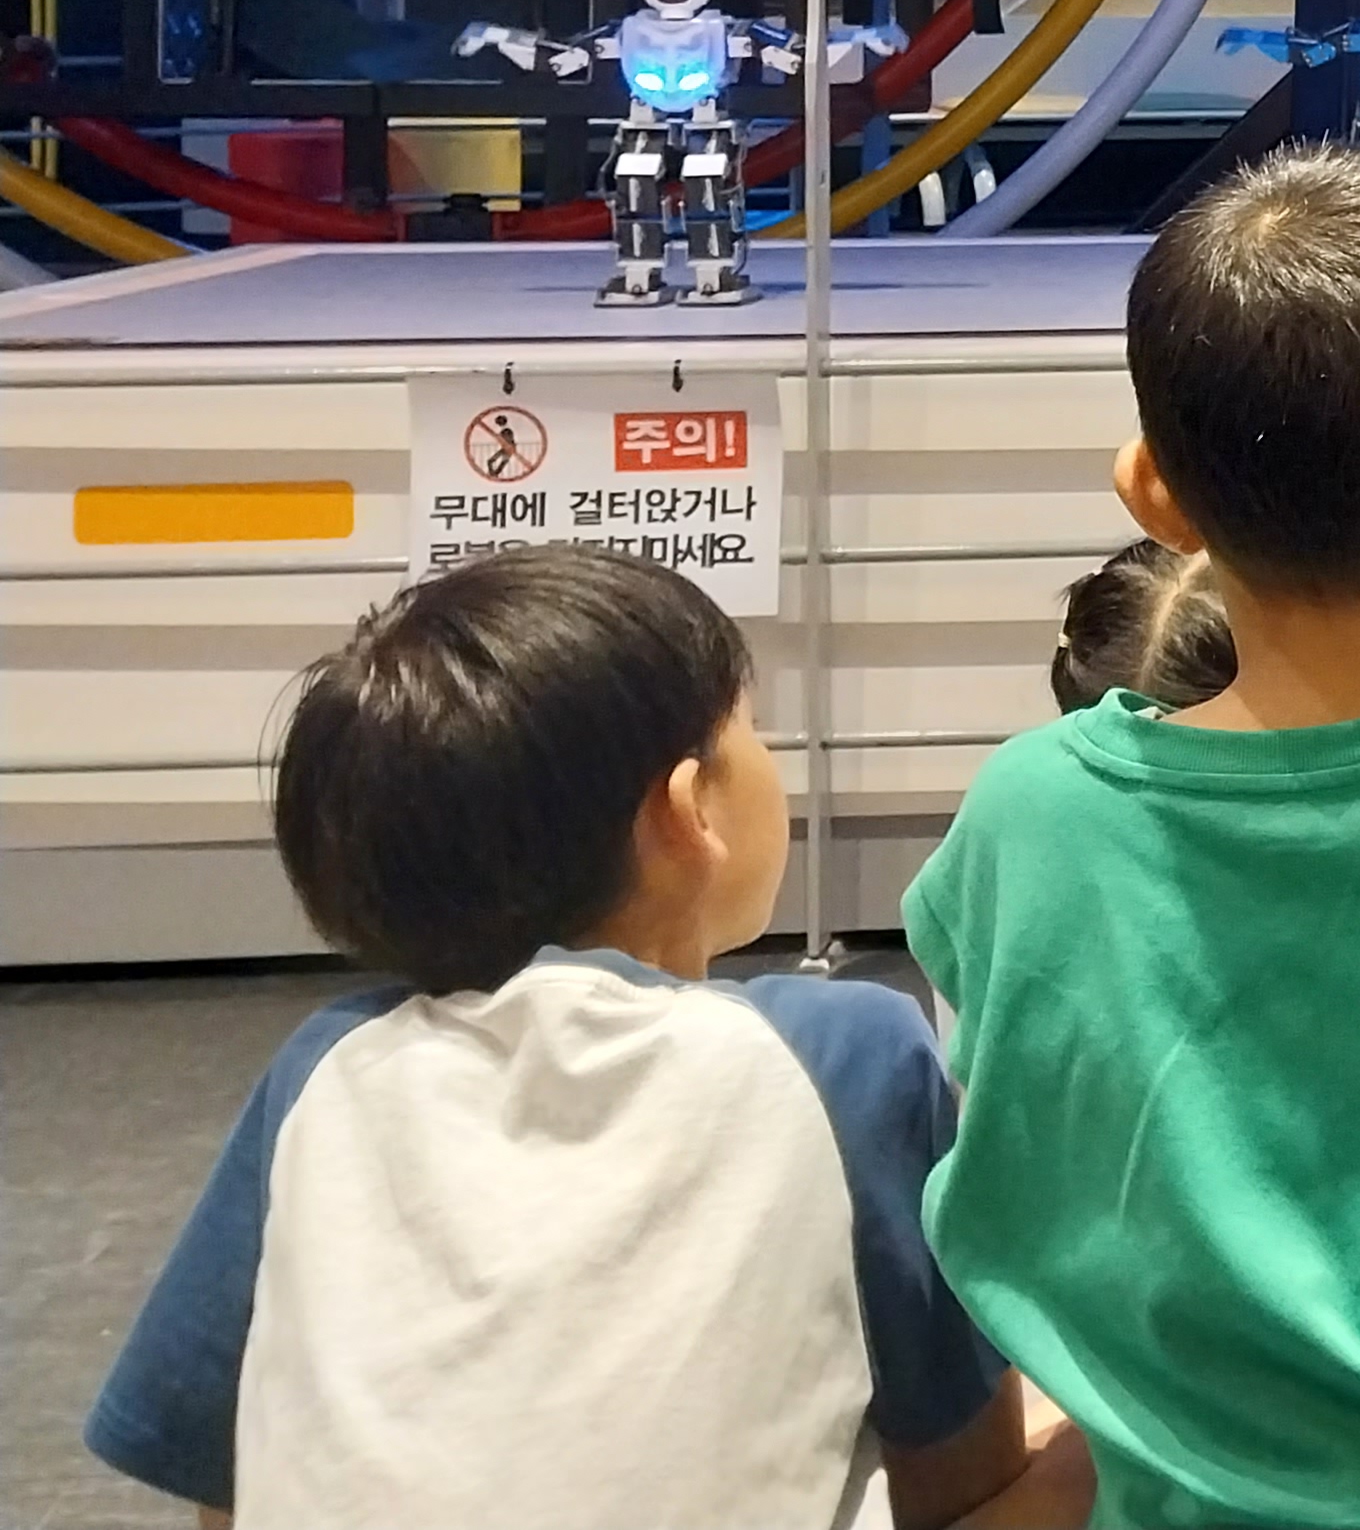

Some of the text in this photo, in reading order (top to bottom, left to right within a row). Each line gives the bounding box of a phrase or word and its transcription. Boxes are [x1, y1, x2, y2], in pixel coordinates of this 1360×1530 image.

[622, 416, 736, 465] 주의!
[430, 485, 758, 531] 무대에 걸터앉거나
